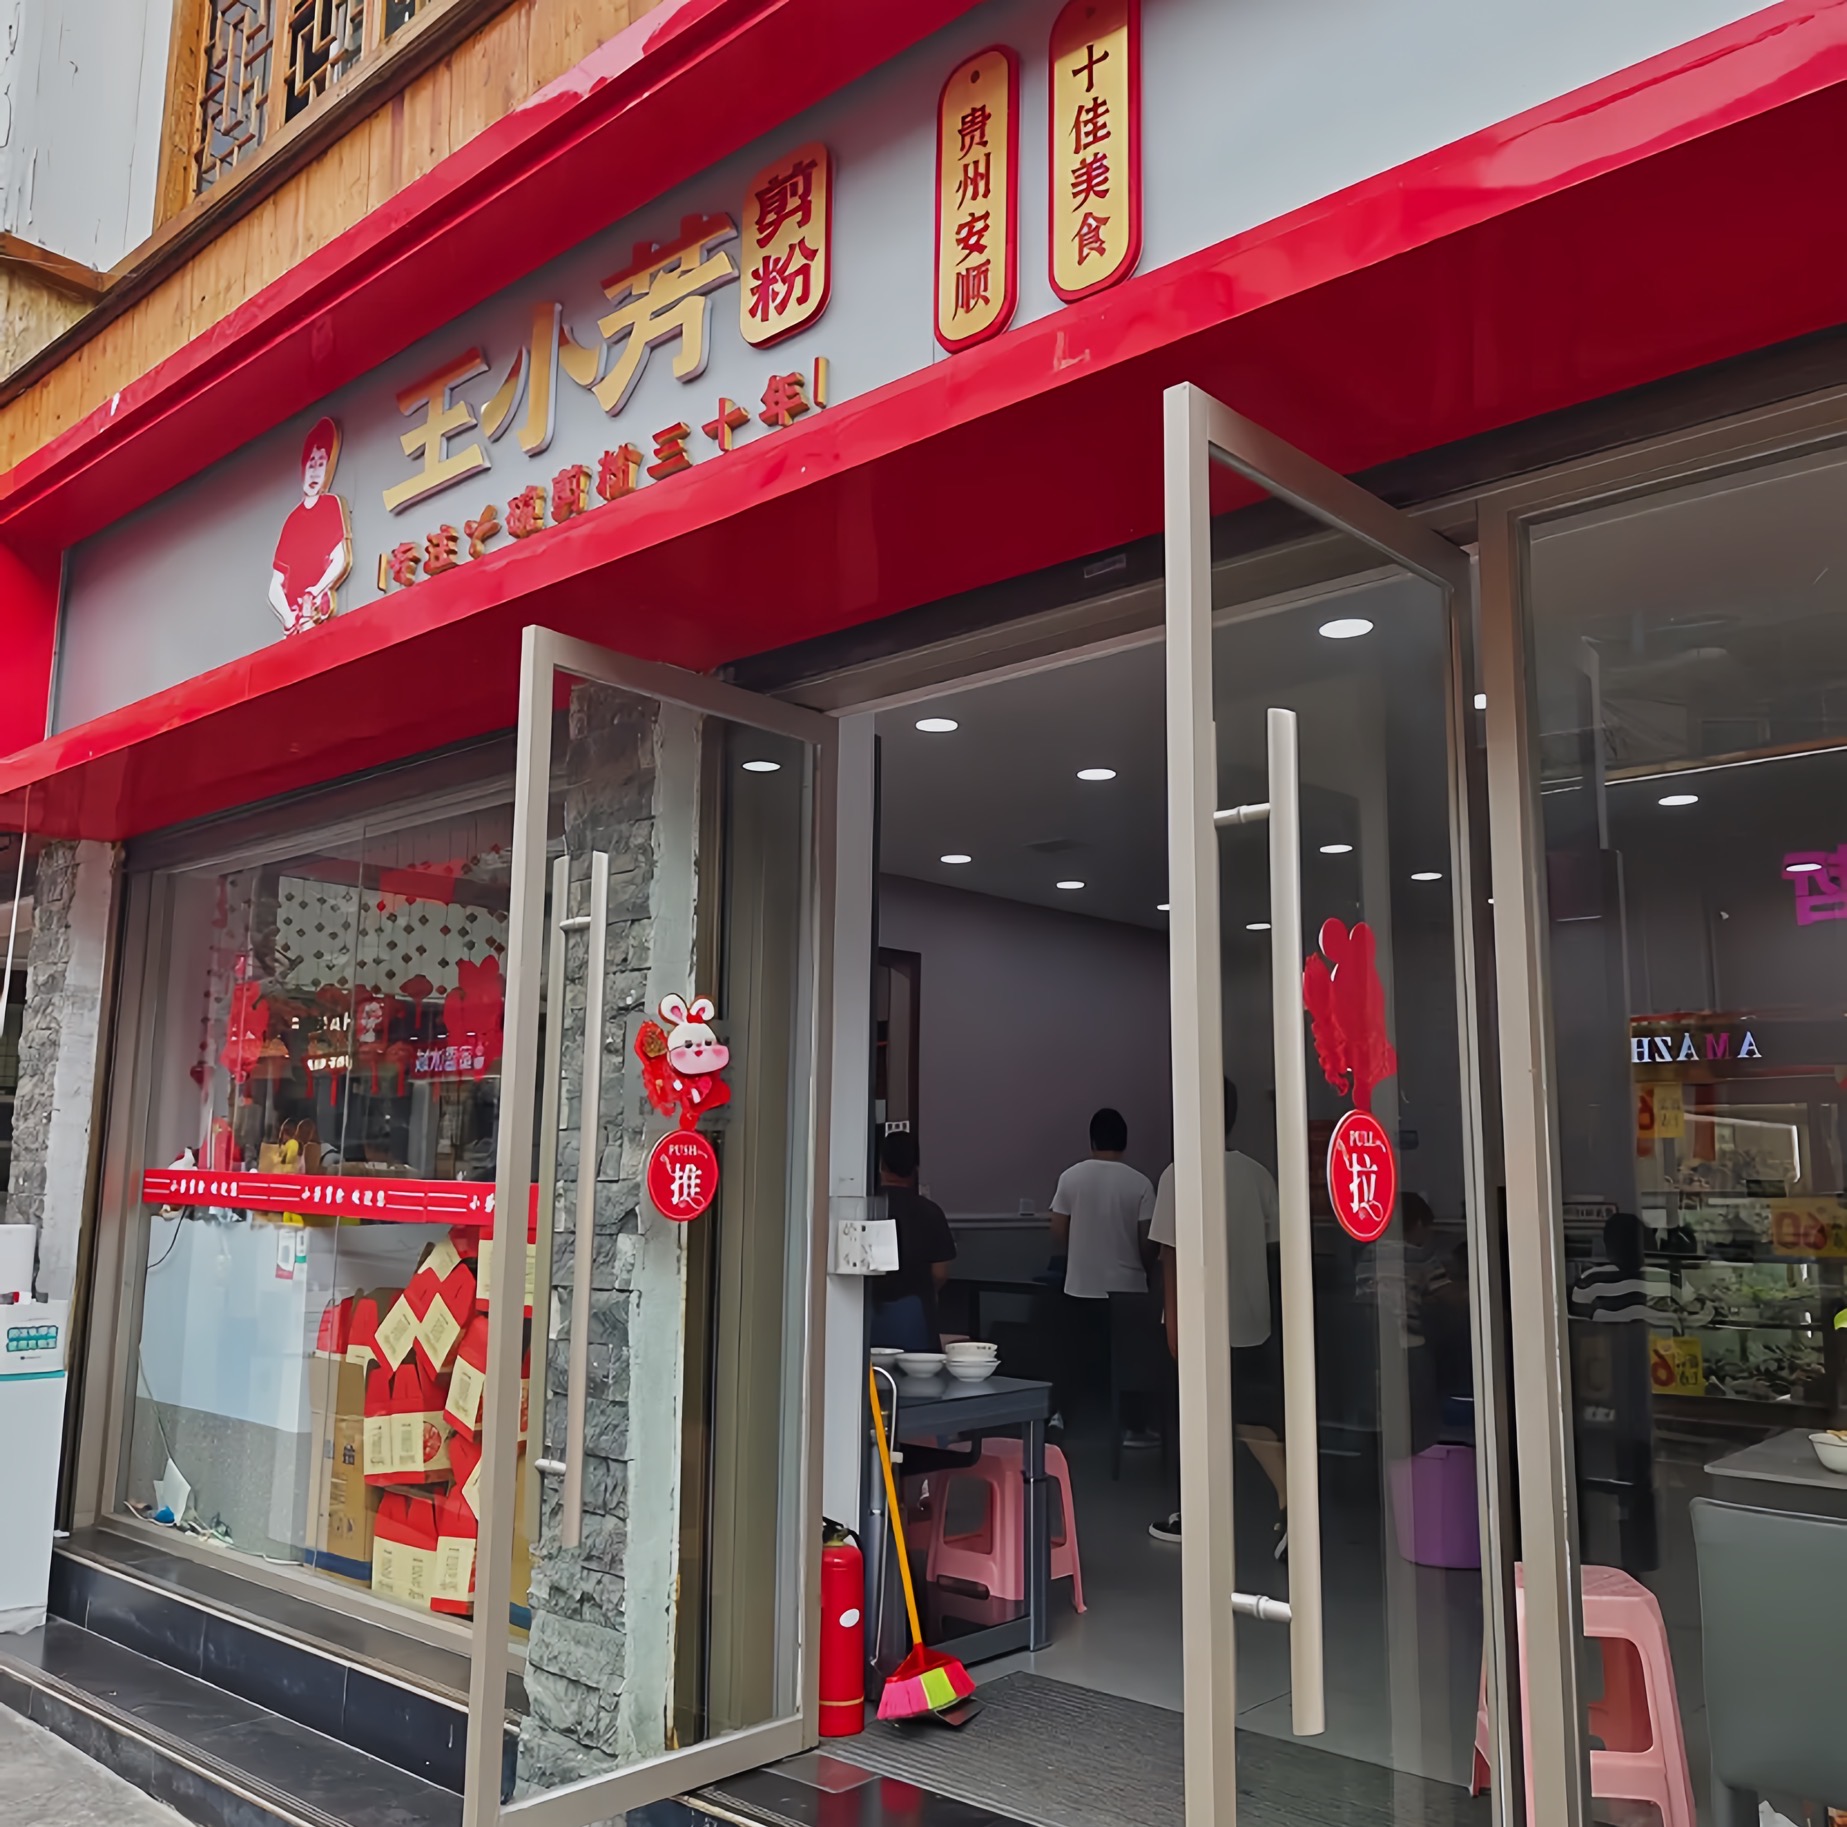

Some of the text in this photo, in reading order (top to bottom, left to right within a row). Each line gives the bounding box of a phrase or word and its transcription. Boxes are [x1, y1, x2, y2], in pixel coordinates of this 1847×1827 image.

[1069, 44, 1111, 265] 十佳美食
[748, 160, 819, 323] 剪粉
[952, 104, 991, 321] 贵州安顺
[383, 211, 740, 515] 王小芳
[668, 1144, 698, 1157] PUSH
[670, 1163, 703, 1205] 推
[1348, 1152, 1378, 1214] 拉
[1349, 1130, 1375, 1147] PULL
